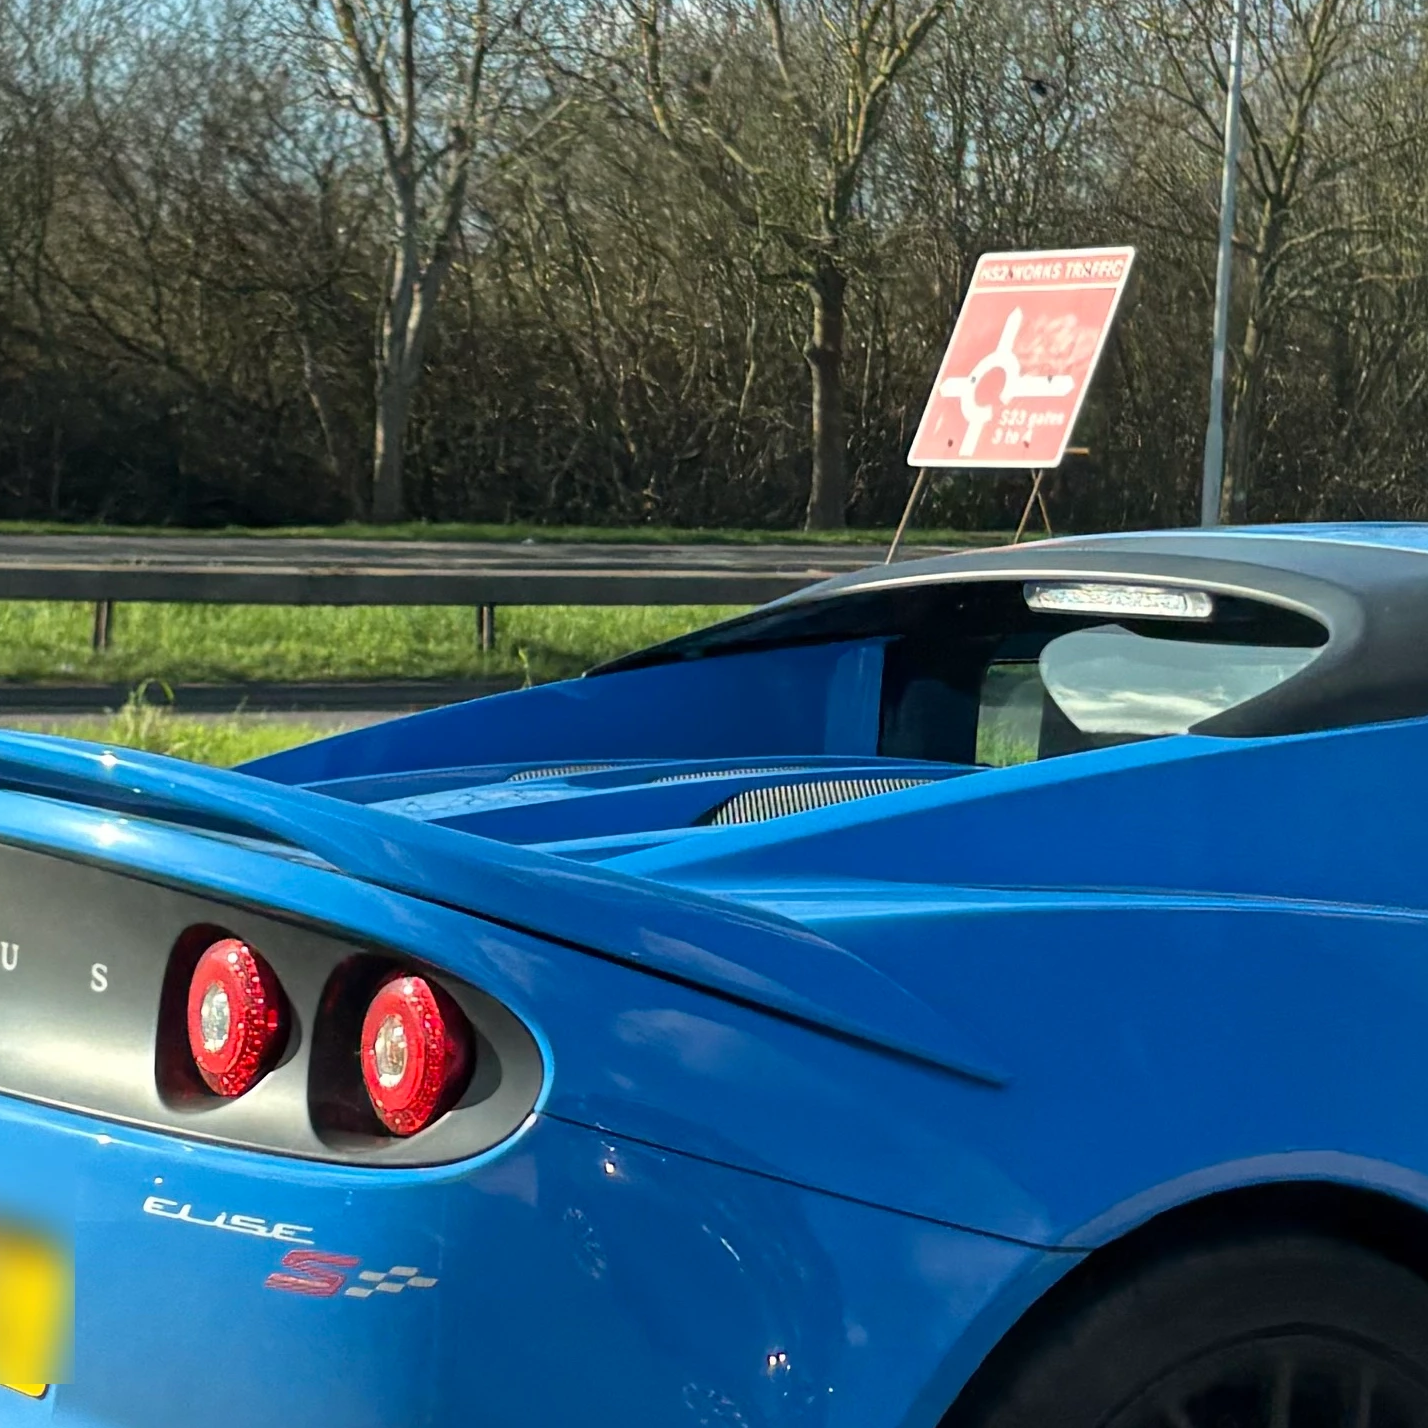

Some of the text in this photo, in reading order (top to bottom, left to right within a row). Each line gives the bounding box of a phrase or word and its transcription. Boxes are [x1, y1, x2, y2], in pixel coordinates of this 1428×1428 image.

[1066, 260, 1123, 278] TRAFFIC
[143, 1196, 315, 1245] ELISE
[264, 1249, 361, 1297] S
